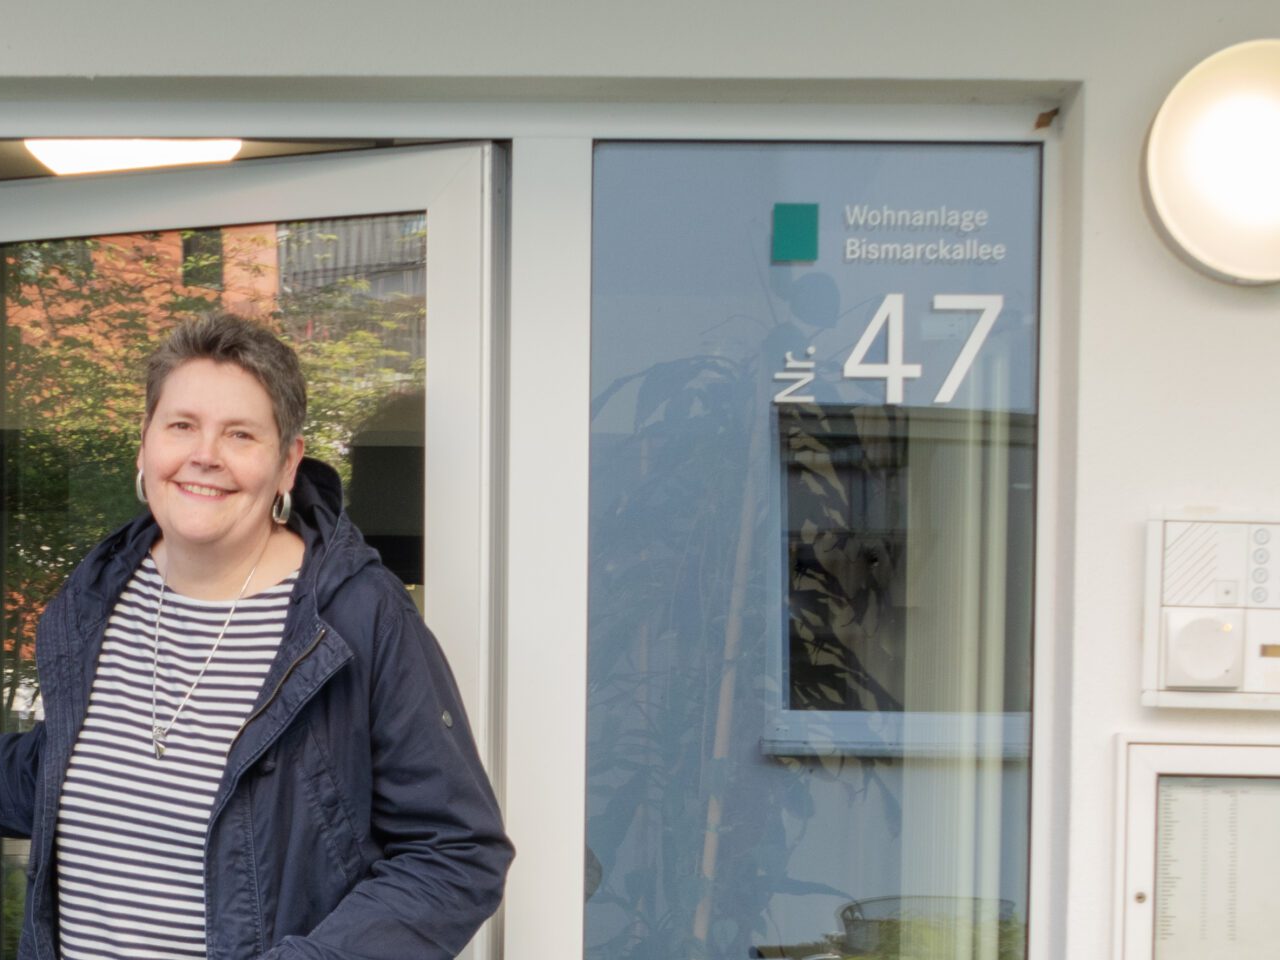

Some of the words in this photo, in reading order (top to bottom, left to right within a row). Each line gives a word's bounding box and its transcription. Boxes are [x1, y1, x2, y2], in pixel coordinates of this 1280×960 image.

[845, 205, 989, 231] Wohnanlage
[845, 238, 1007, 261] Bismarckallee
[774, 345, 815, 403] Nr.
[843, 293, 1004, 404] 47
